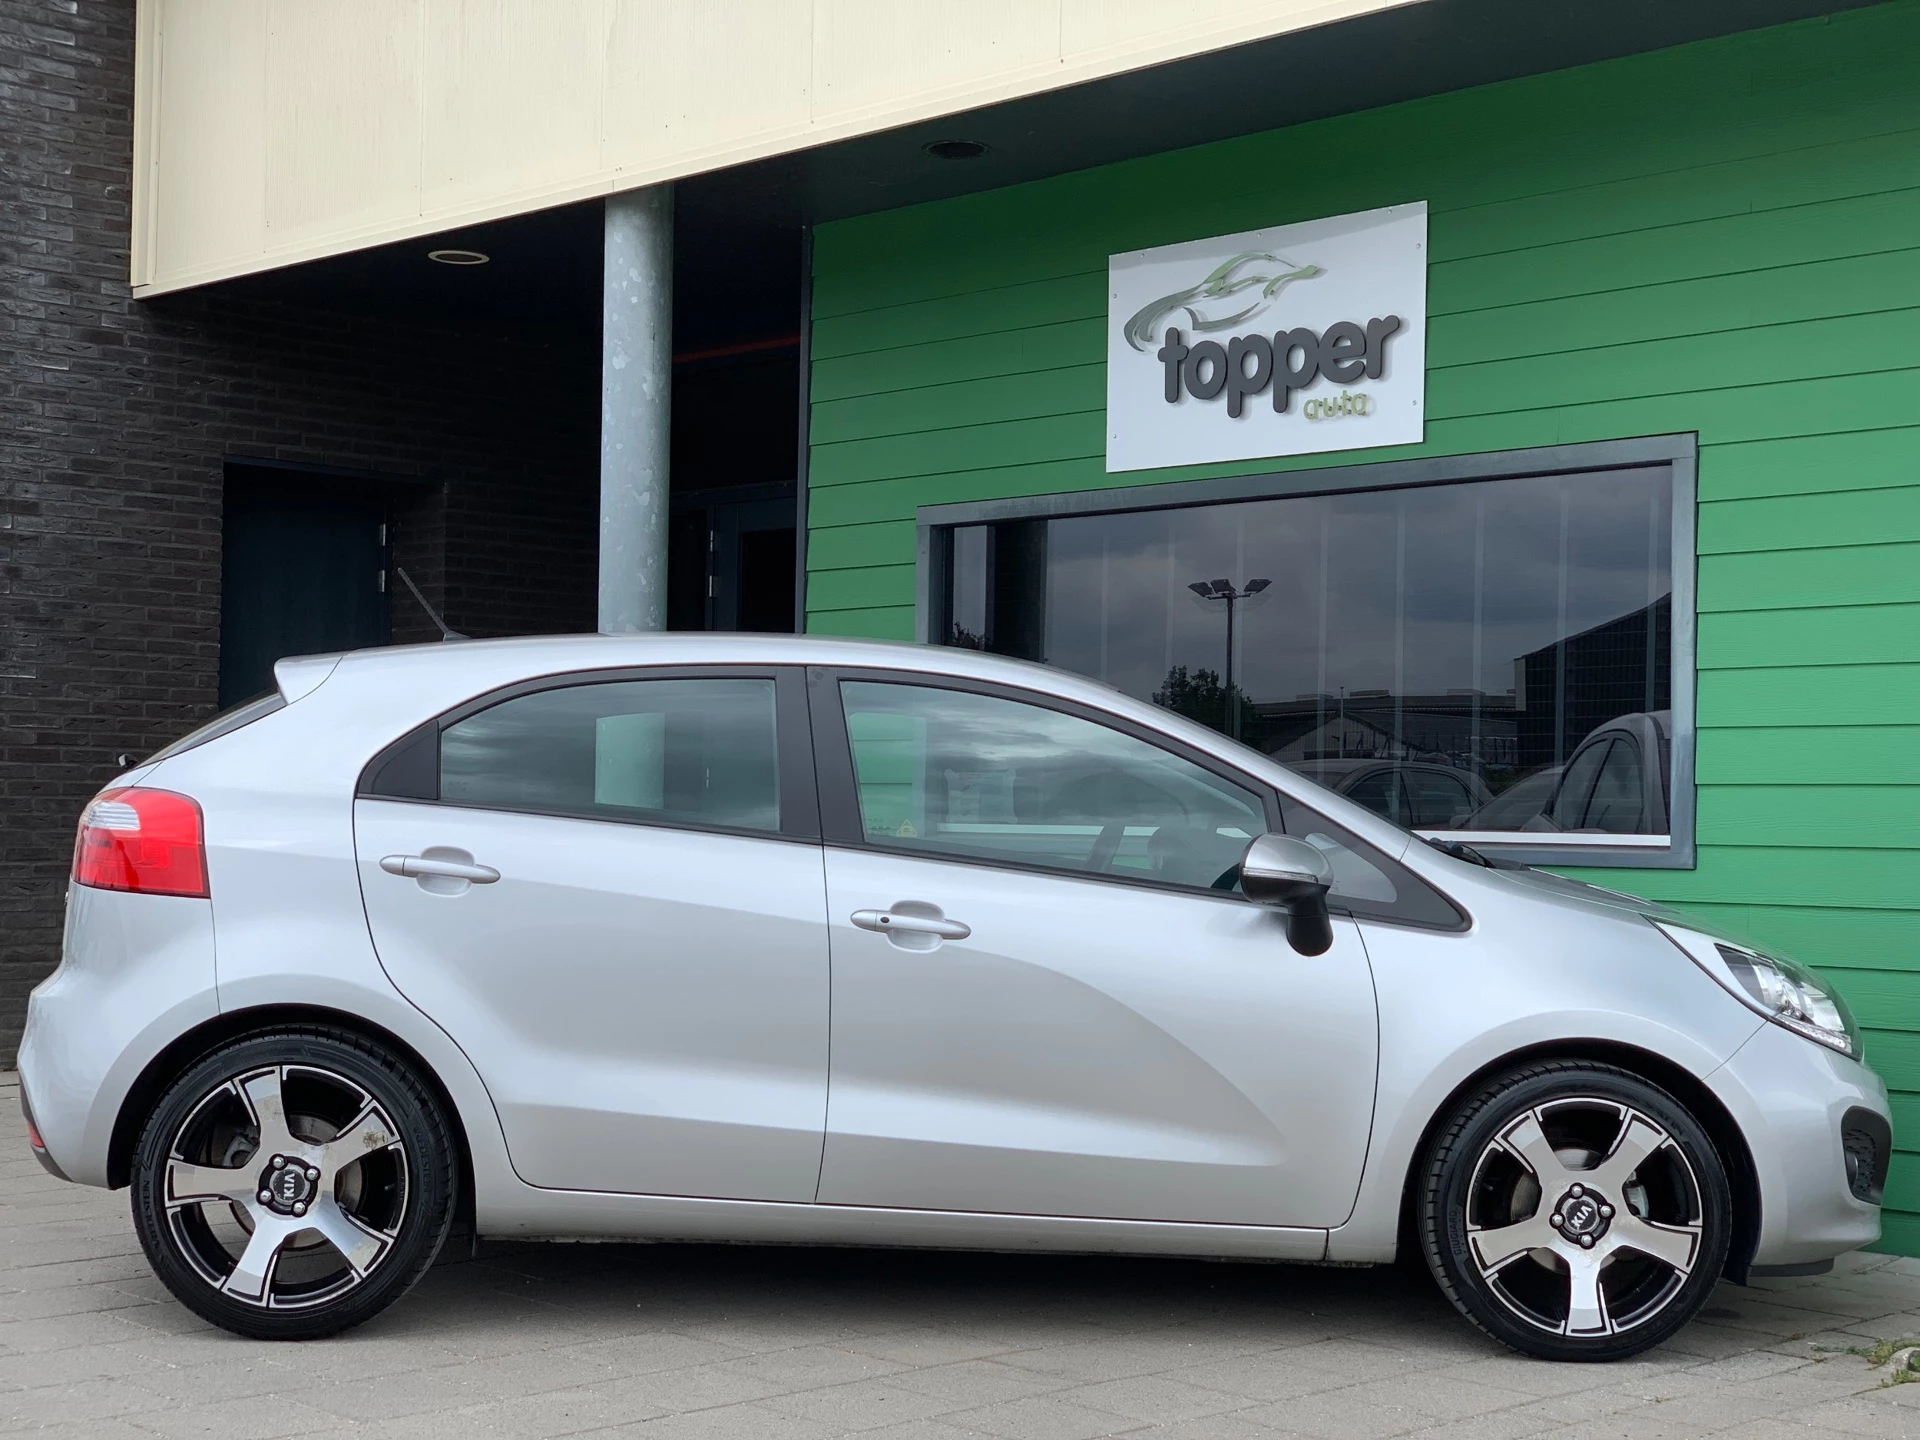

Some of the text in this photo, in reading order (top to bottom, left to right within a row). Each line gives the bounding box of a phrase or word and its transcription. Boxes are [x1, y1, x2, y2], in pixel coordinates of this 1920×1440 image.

[1158, 315, 1400, 418] topper
[1303, 390, 1368, 420] auto
[284, 1173, 295, 1198] KIA
[1571, 1205, 1593, 1228] KIA
